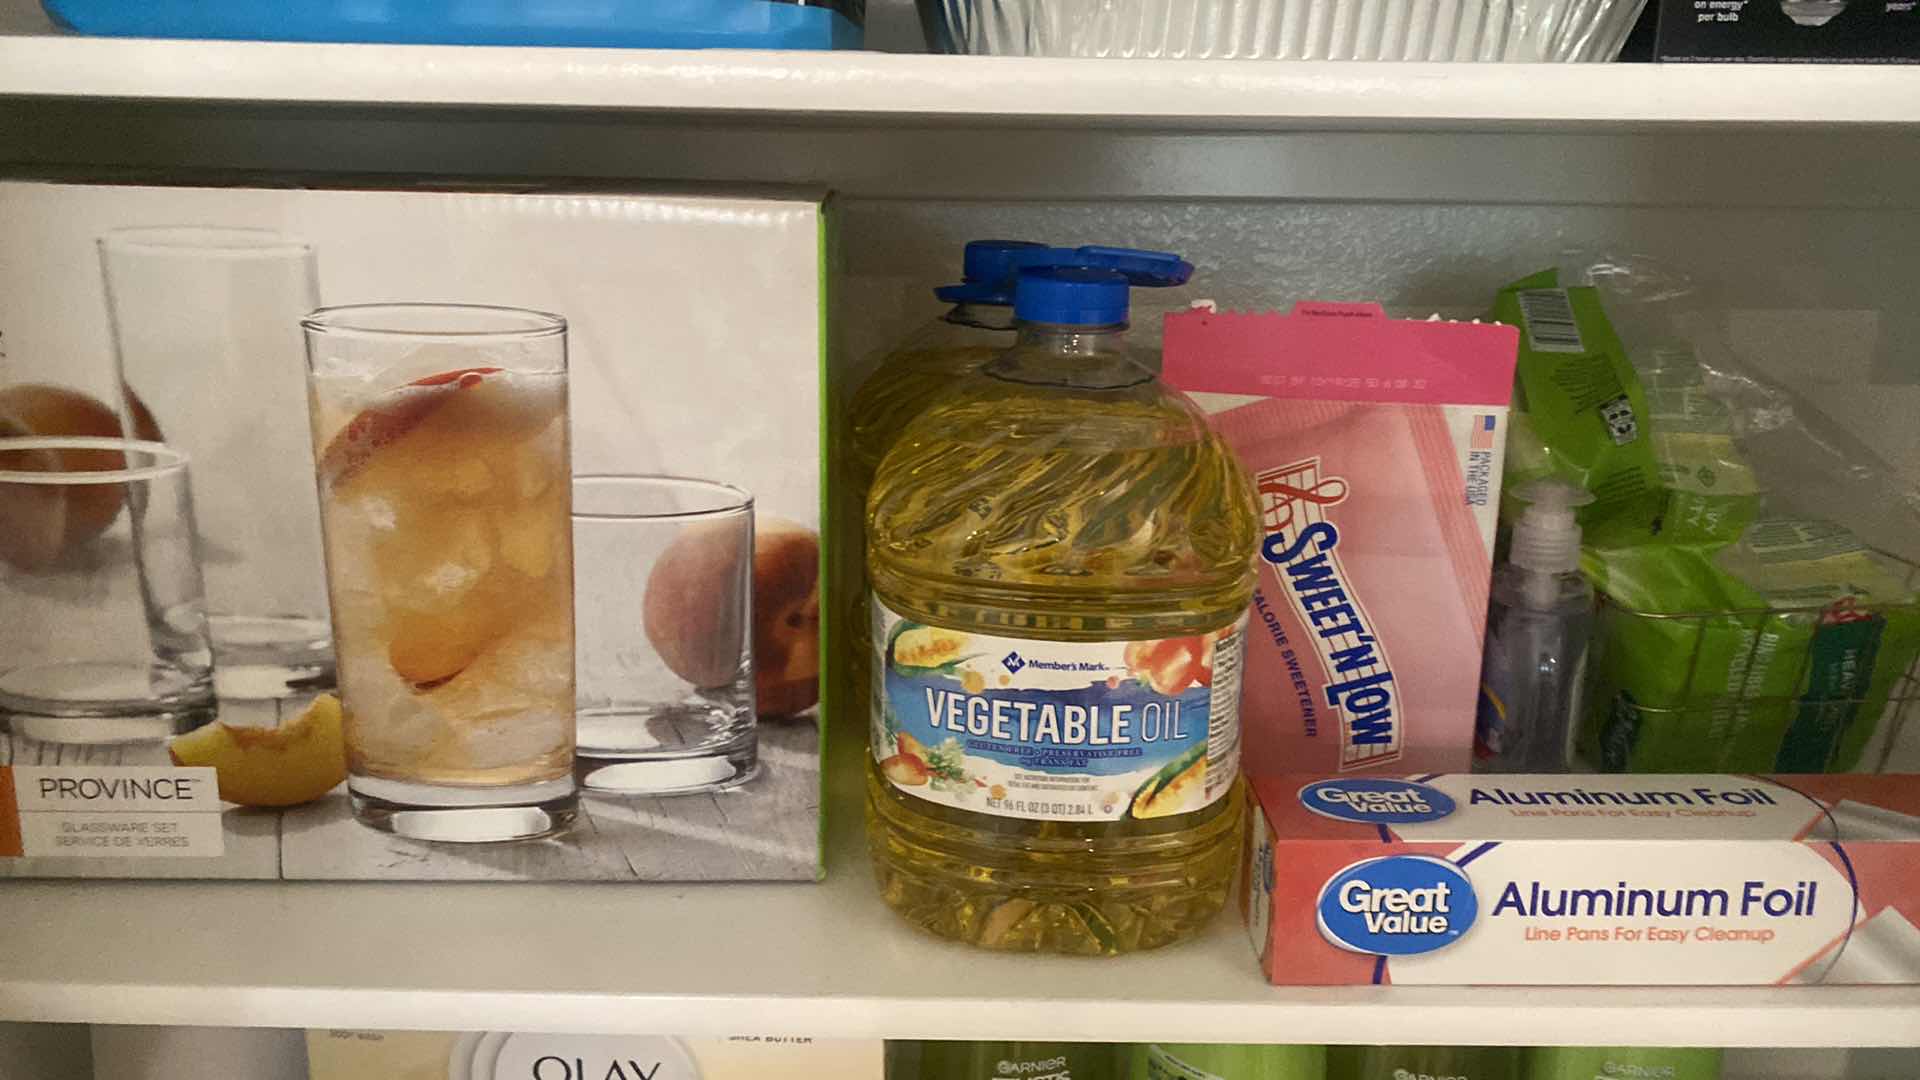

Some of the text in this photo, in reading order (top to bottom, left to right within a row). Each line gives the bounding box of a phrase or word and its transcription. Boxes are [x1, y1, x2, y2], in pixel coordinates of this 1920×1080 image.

[1694, 1, 1707, 9] on
[1697, 13, 1739, 23] per bulb
[1475, 451, 1491, 506] PACKAGED
[1029, 659, 1105, 671] Member's Mark
[1280, 650, 1317, 737] SWEETENER
[925, 687, 1189, 746] VEGETABLE OIL
[1325, 671, 1393, 746] LOW
[39, 778, 193, 799] PROVINCE
[1316, 787, 1426, 804] Great
[1470, 788, 1777, 805] Aluminum Foil
[986, 798, 1001, 808] NET
[1004, 800, 1013, 810] 96
[1016, 801, 1026, 812] FL
[1028, 802, 1039, 813] OZ
[1350, 801, 1432, 813] Value
[1675, 808, 1756, 818] Cleanup
[62, 821, 178, 833] GLASSWARE SET
[55, 836, 190, 848] SERVICE DE VERRES
[1339, 879, 1451, 913] Great
[1491, 881, 1818, 917] Aluminum Foil
[1364, 911, 1448, 934] Value
[1525, 926, 1776, 945] Line Pans For Easy Cleanup
[997, 1056, 1067, 1075] GARNIER
